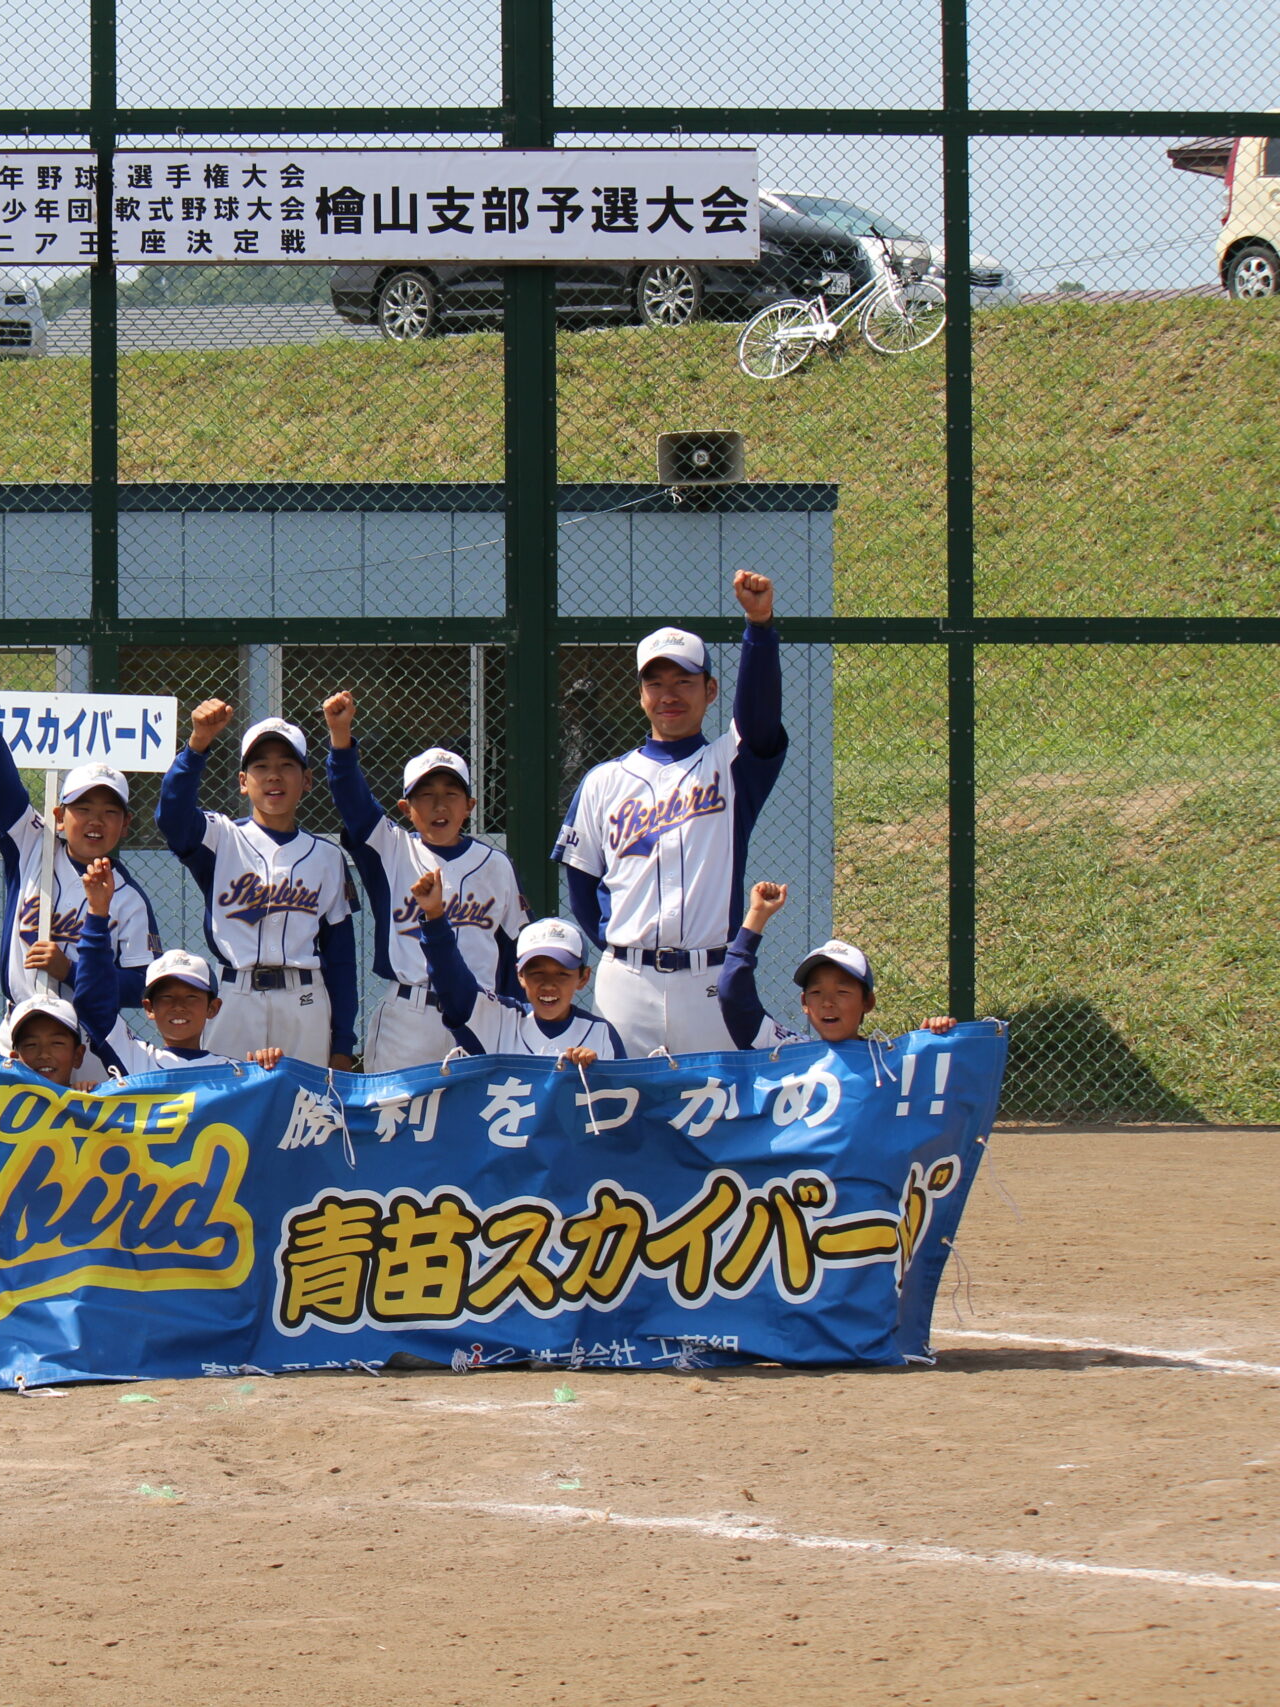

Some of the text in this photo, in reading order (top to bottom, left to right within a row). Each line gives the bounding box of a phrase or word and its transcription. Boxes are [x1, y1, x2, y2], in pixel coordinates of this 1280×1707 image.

[316, 185, 749, 235] 檜山支部予選大会
[218, 871, 322, 913] Skybird
[393, 893, 496, 931] Sbird
